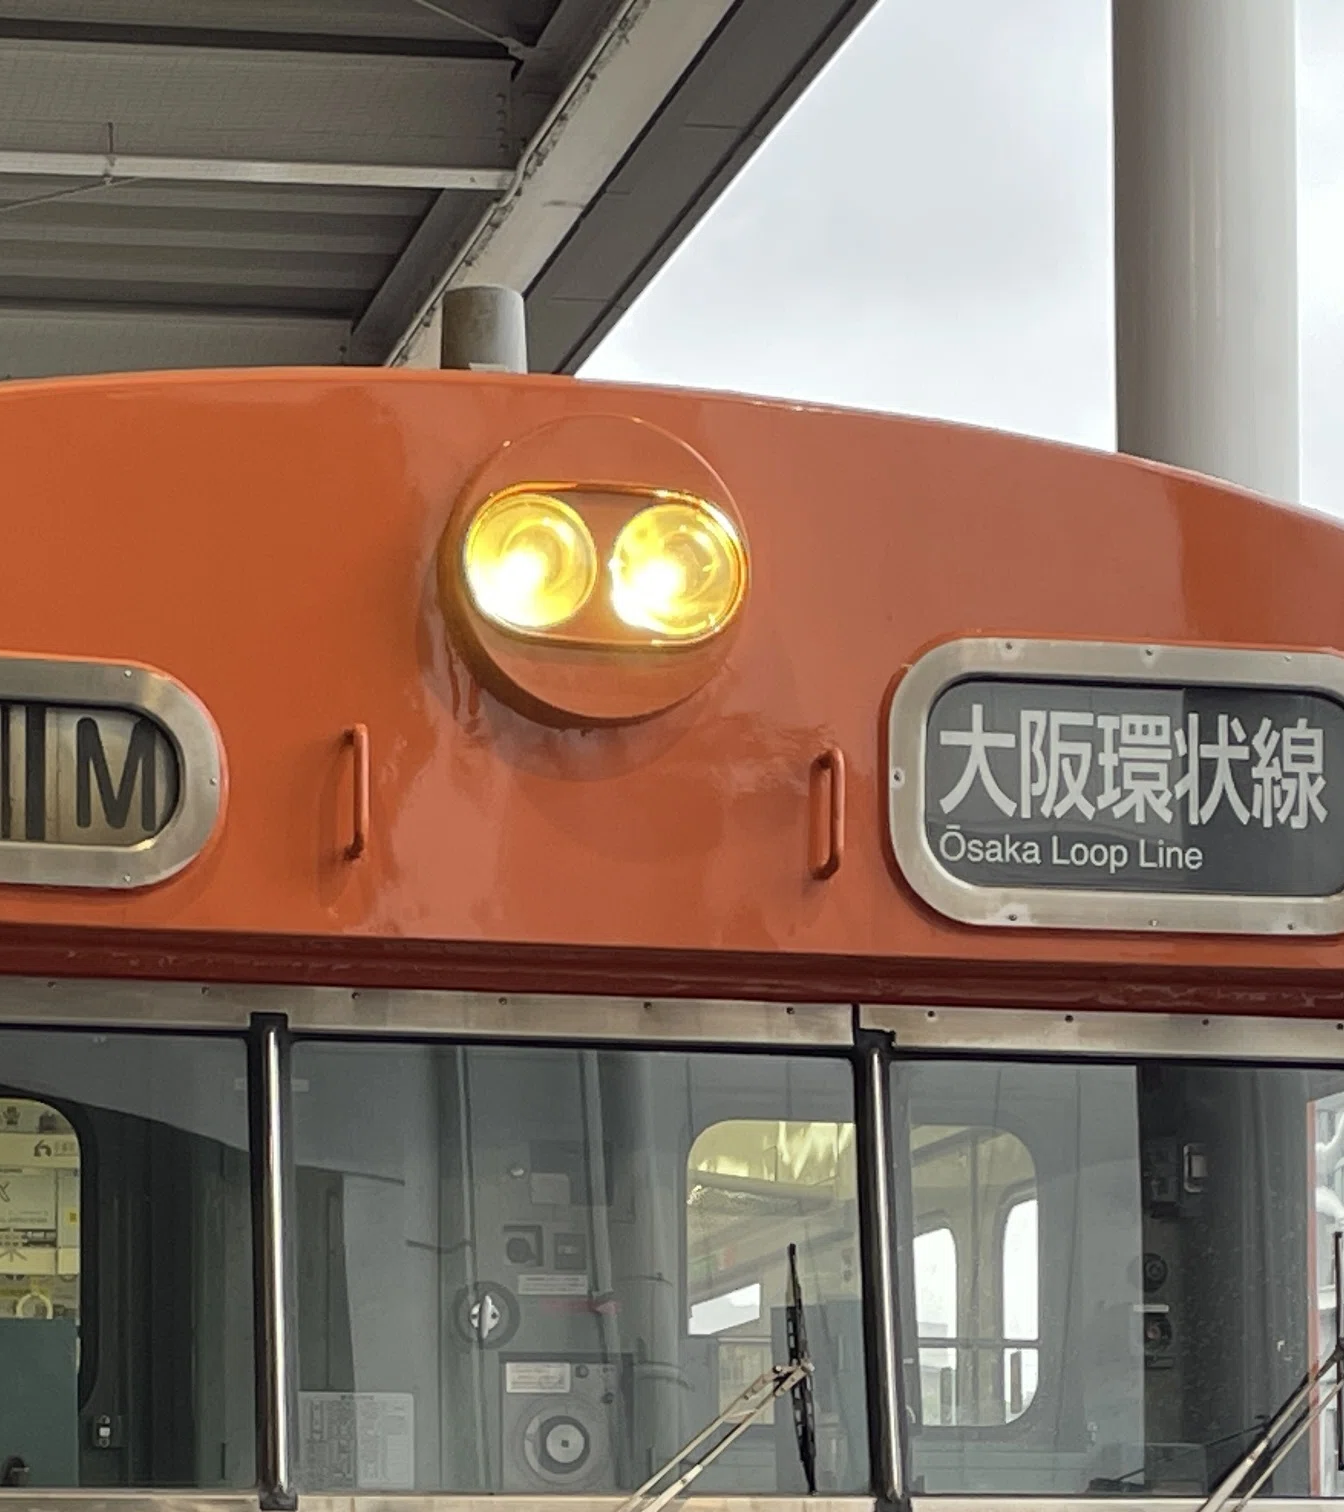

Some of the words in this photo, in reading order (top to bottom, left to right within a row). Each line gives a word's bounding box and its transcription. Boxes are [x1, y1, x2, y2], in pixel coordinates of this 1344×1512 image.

[939, 704, 1329, 829] 大阪環状線
[939, 824, 1042, 865] Ōsaka
[1052, 835, 1128, 873] Loop
[1138, 839, 1204, 870] Line
